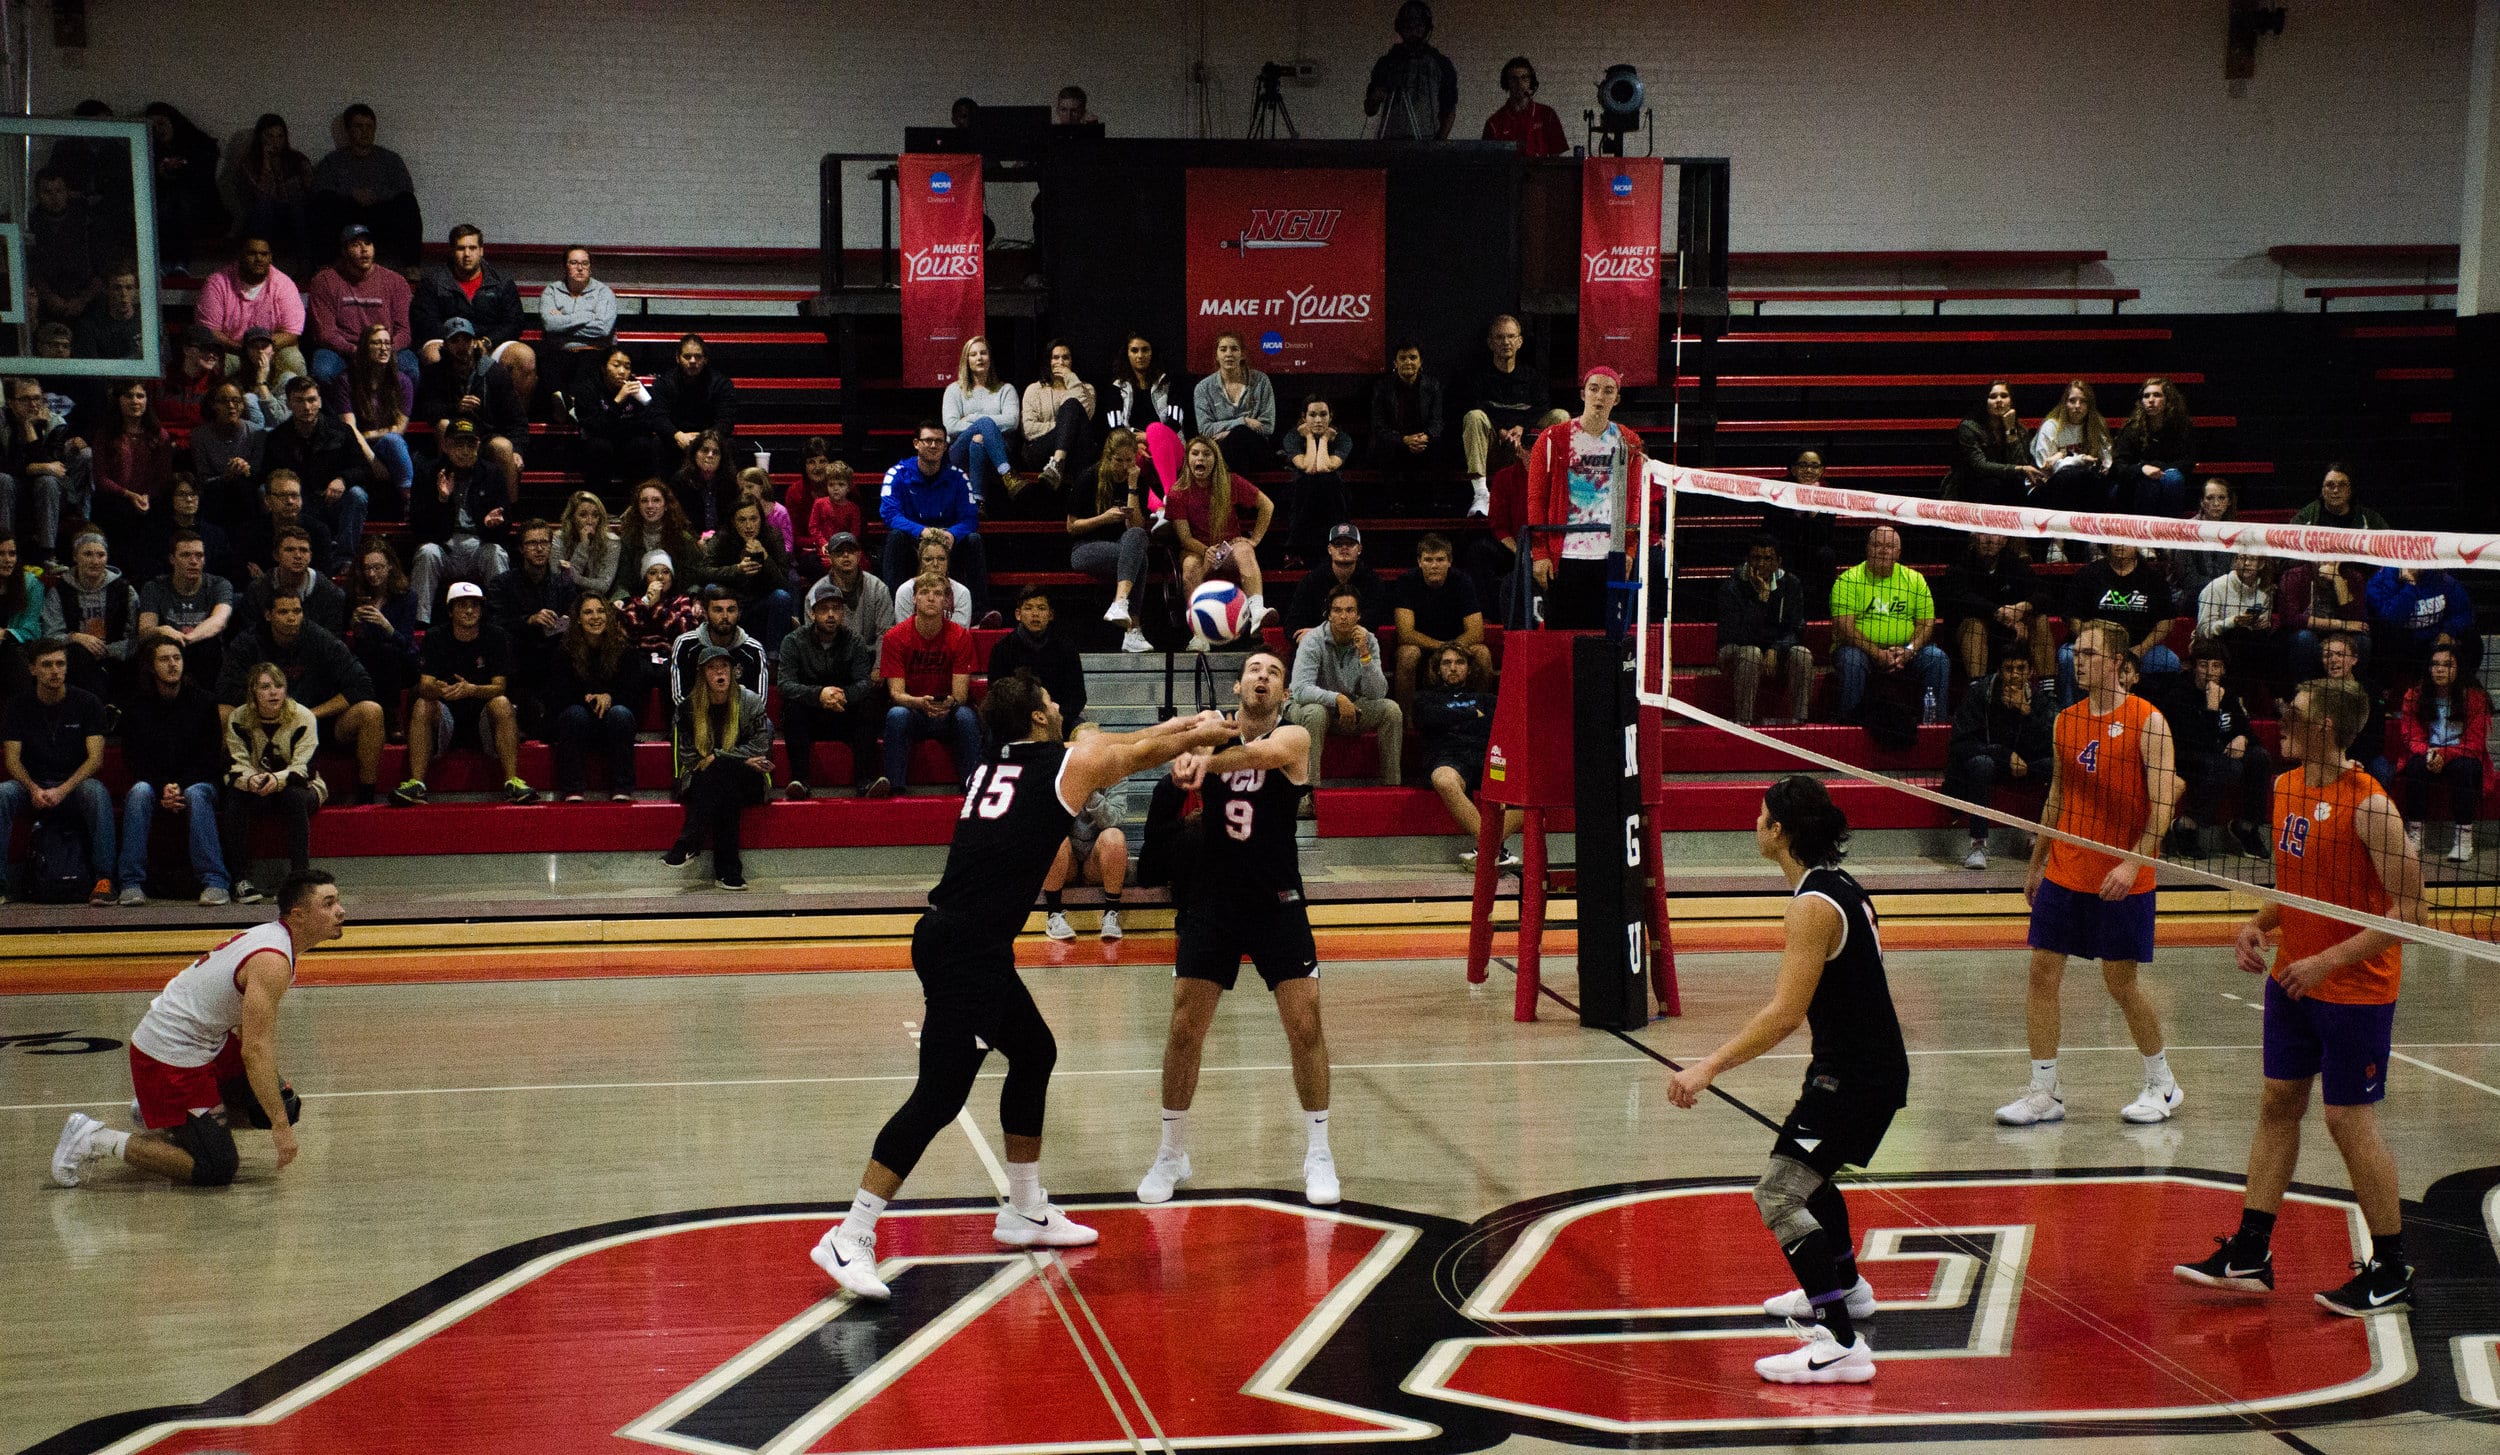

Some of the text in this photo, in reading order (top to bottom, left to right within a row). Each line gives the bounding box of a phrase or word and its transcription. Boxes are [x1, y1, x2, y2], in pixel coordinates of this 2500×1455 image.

[931, 182, 952, 190] NCAA
[1244, 209, 1342, 240] NGU
[932, 244, 980, 254] MAKE IT
[1611, 246, 1657, 256] MAKE IT
[904, 247, 979, 283] YOURS
[1583, 249, 1655, 283] YOURS
[1199, 284, 1371, 326] MAKE IT YOURS
[1262, 341, 1283, 349] NCAA
[2070, 515, 2204, 543] NORTH GREENVILLE UNIVERSITY
[2265, 529, 2439, 560] NORTH GREENVILLE UNIVERSITY
[2077, 740, 2100, 772] 4
[960, 763, 1023, 819] 15
[1225, 799, 1254, 842] 9
[2278, 812, 2311, 859] 19
